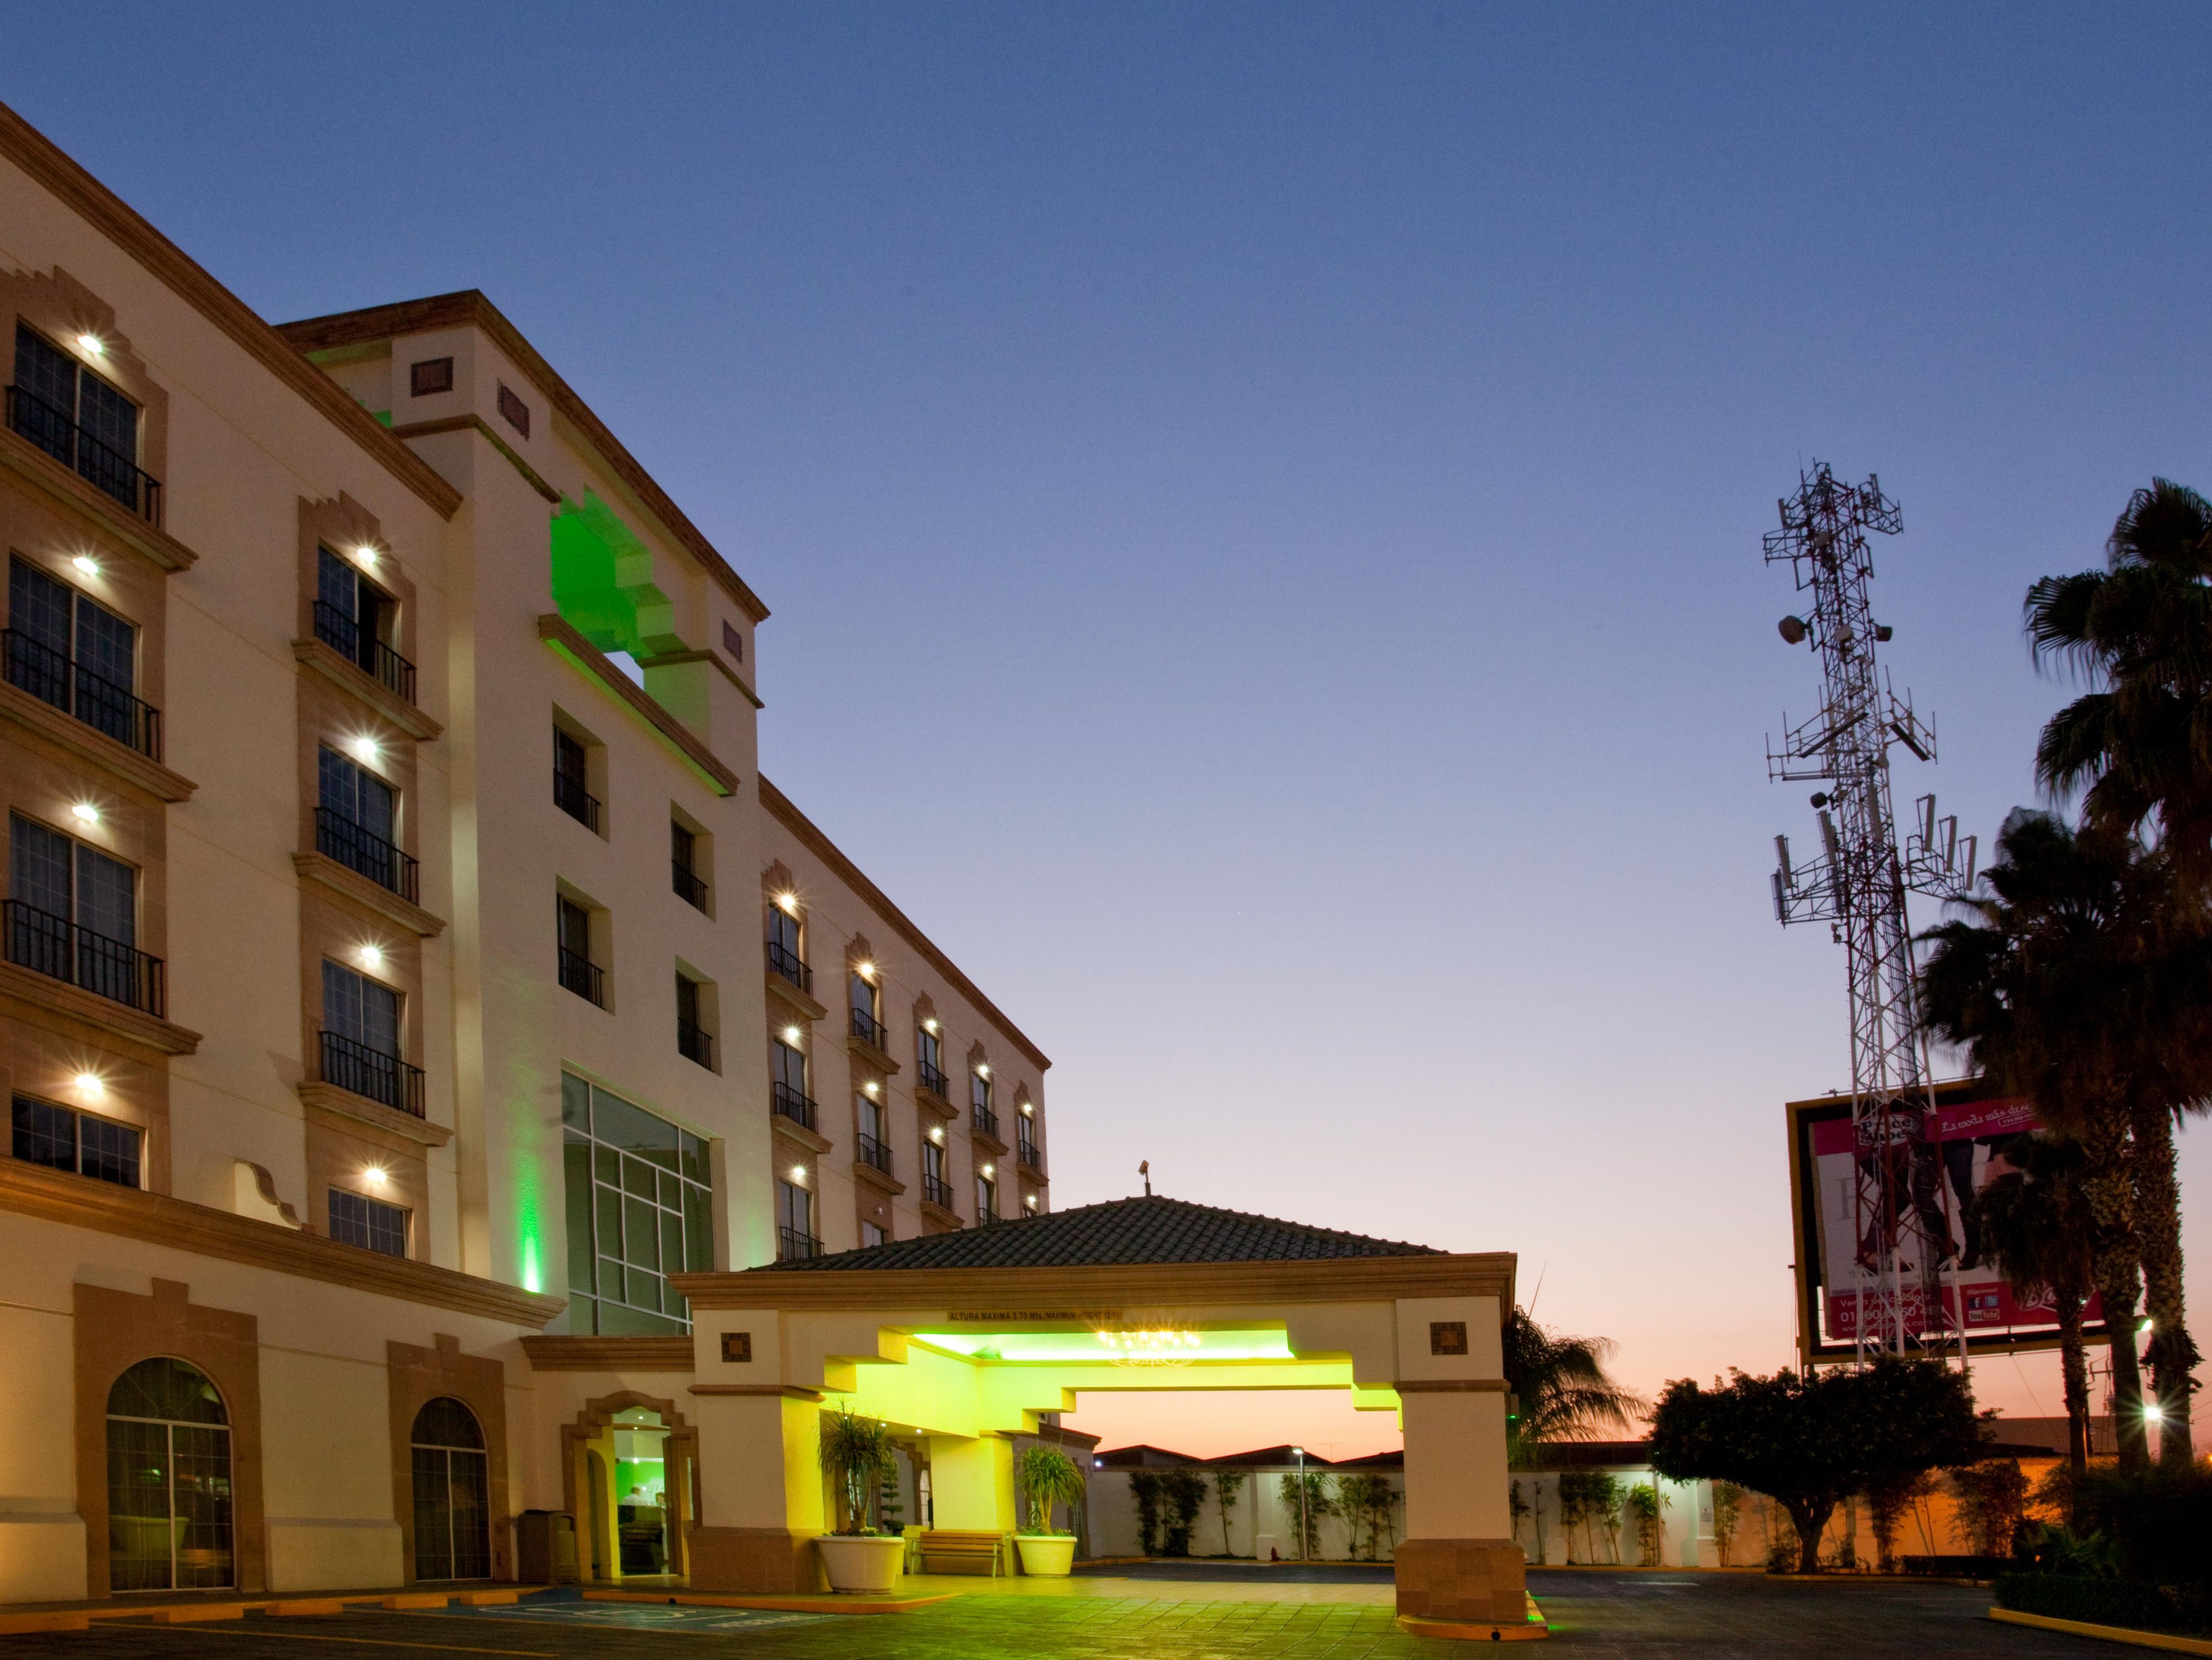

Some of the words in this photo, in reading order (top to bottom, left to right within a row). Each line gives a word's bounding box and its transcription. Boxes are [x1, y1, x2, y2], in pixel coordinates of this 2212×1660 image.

[1958, 1114, 1984, 1129] moda
[950, 1312, 979, 1320] ALTURA
[982, 1312, 1011, 1320] MAXIMA
[1013, 1312, 1027, 1320] 3.70
